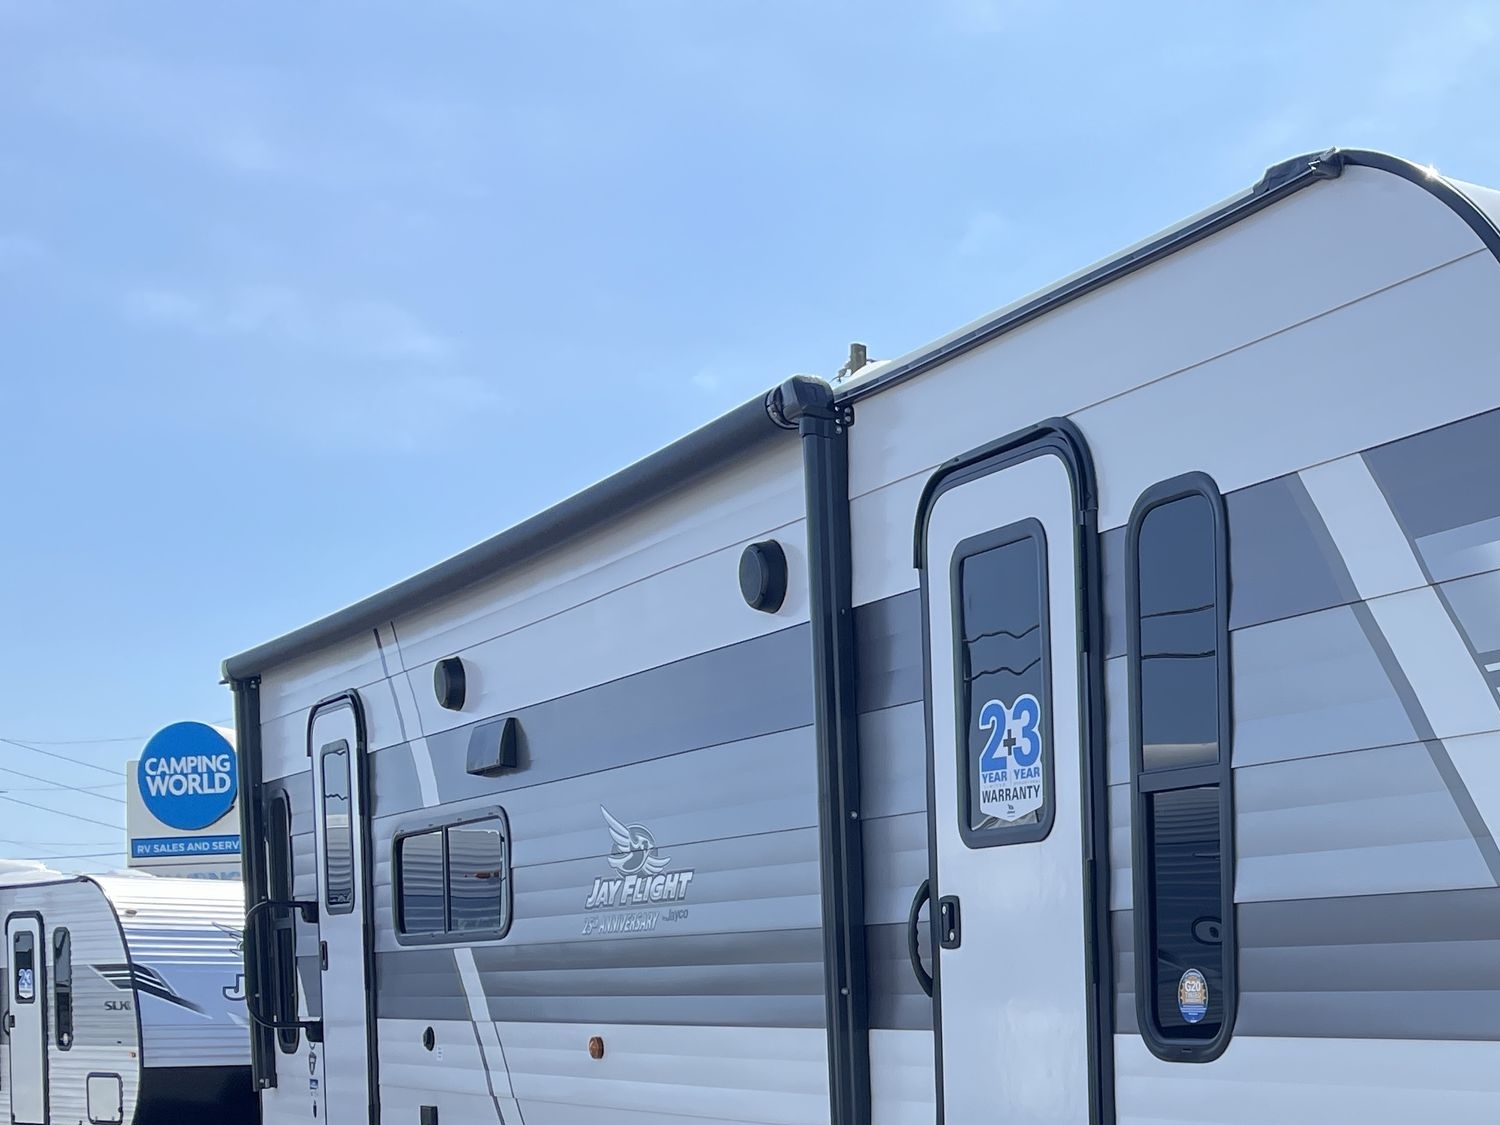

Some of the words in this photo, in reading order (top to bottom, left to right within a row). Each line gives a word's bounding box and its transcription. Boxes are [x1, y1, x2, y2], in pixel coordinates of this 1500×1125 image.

[144, 754, 231, 776] CAMPING
[982, 770, 1008, 785] YEAR
[1013, 766, 1040, 781] YEAR
[146, 772, 231, 797] WORLD
[982, 784, 1041, 804] WARRANTY
[137, 844, 151, 854] RV
[153, 842, 185, 853] SALES
[186, 841, 210, 852] AND
[585, 877, 622, 910] JAY
[619, 868, 695, 905] FLIGHT
